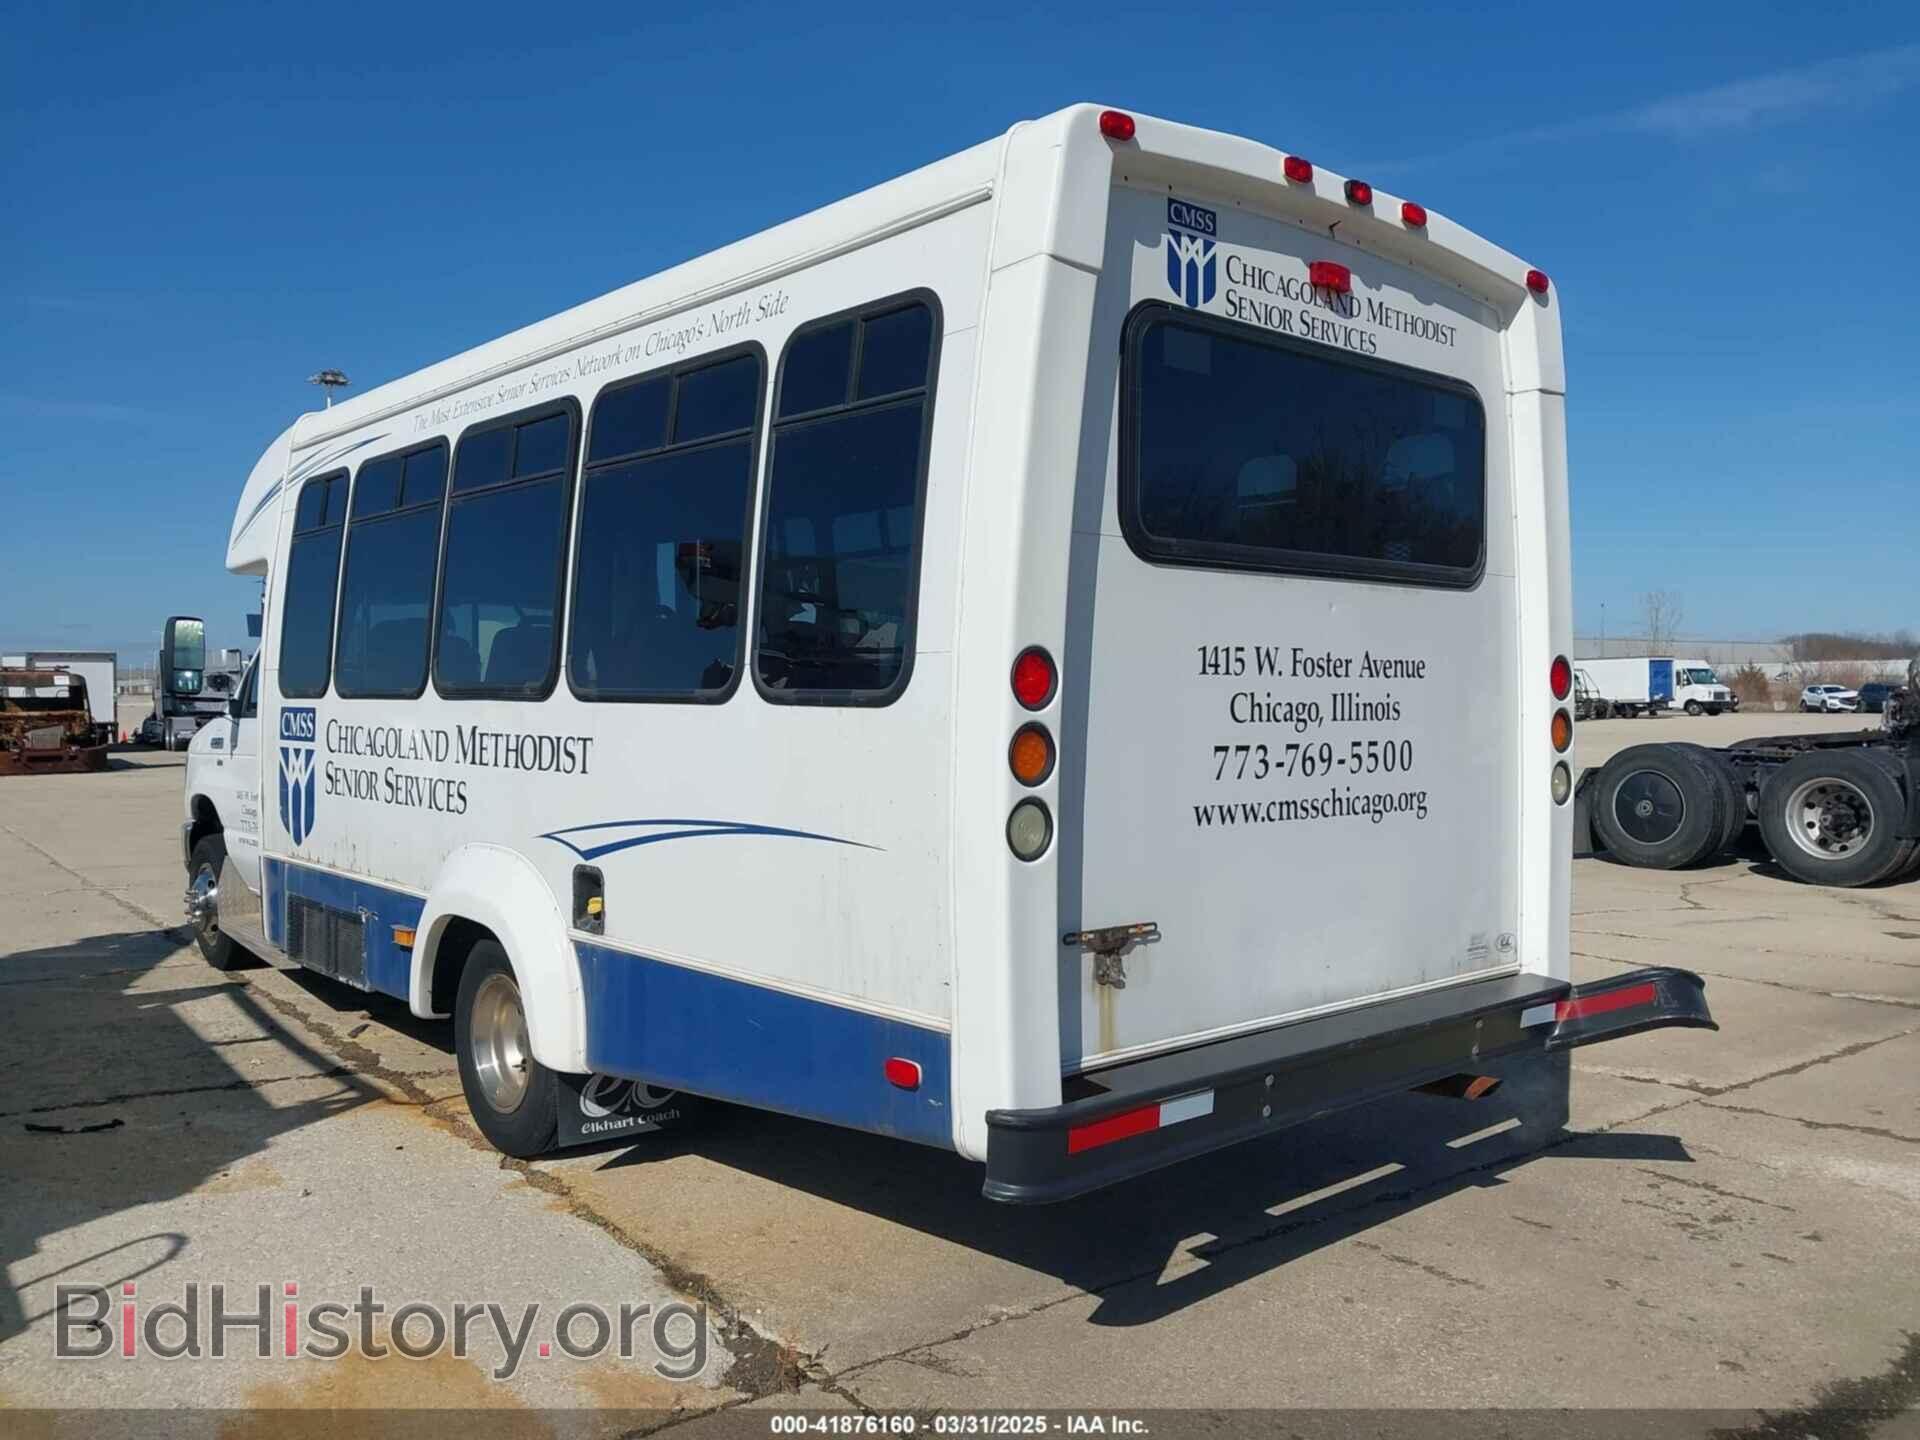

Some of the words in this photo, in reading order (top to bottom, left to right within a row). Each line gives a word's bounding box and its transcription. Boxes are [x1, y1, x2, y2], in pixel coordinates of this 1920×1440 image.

[1169, 202, 1215, 232] CMSS
[574, 344, 622, 380] Network
[625, 343, 641, 360] on
[645, 318, 704, 356] Chicago's
[707, 301, 751, 337] North
[756, 290, 790, 322] Side
[1197, 646, 1246, 677] 1415
[1254, 646, 1283, 677] W.
[1291, 648, 1352, 678] Foster
[1358, 650, 1426, 679] Avenue
[281, 711, 315, 739] CMSS
[1230, 692, 1325, 733] Chicago,
[1330, 692, 1401, 722] Illinois
[1213, 739, 1413, 781] 773-769-5500
[1193, 786, 1428, 827] www.cmsschicago.org
